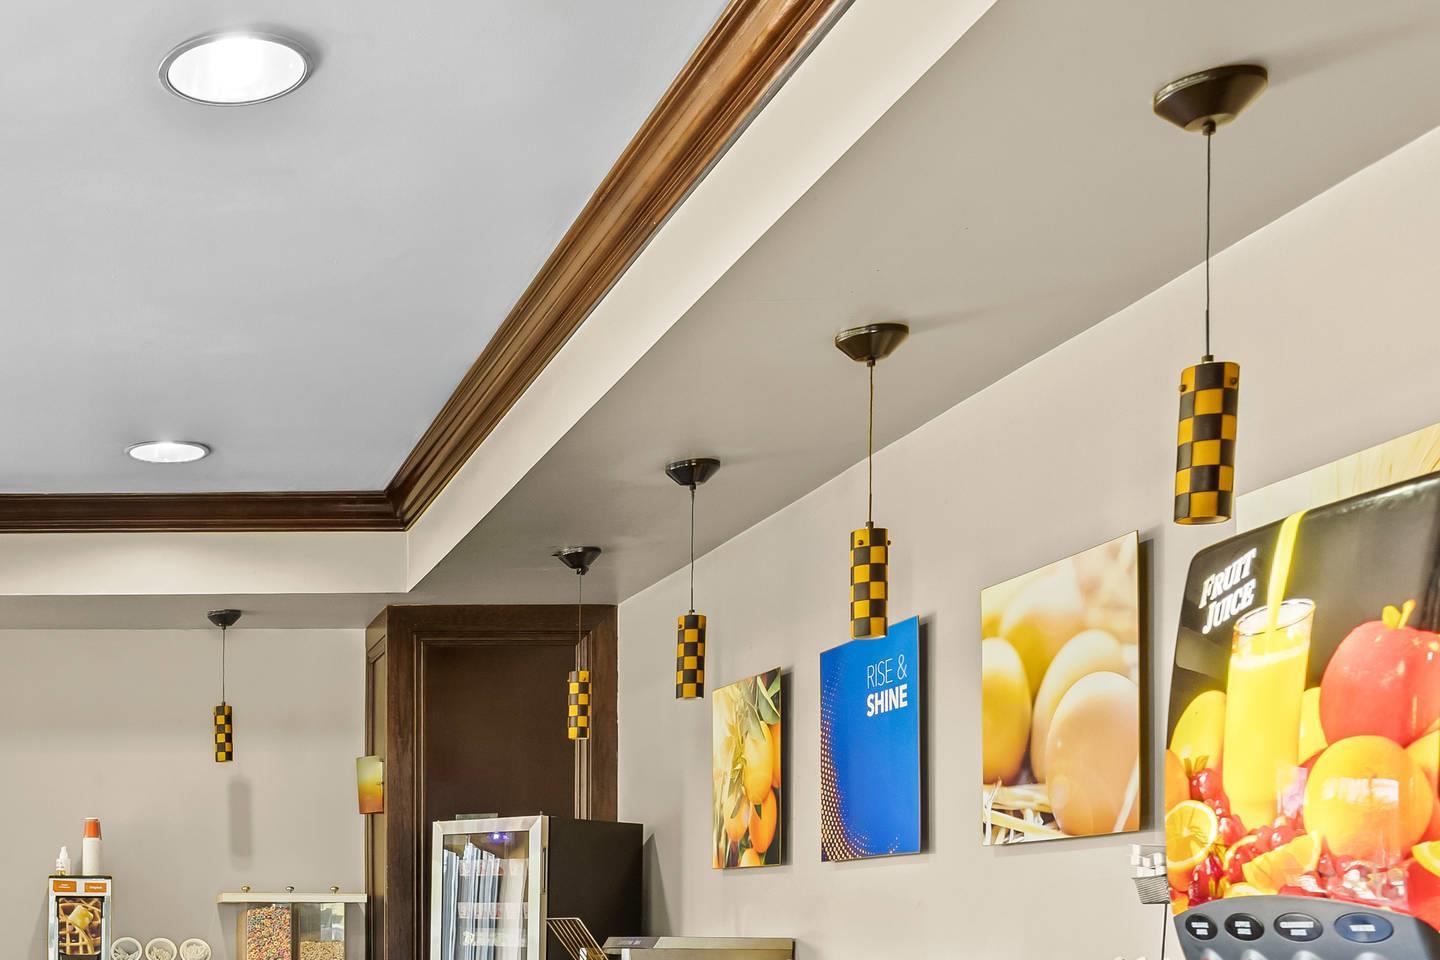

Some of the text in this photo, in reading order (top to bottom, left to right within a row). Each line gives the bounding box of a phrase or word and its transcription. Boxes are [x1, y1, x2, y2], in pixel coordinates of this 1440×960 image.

[1198, 547, 1257, 609] FRUIT
[1202, 578, 1257, 634] JUICE
[867, 654, 908, 689] RISE &
[866, 684, 908, 717] SHINE
